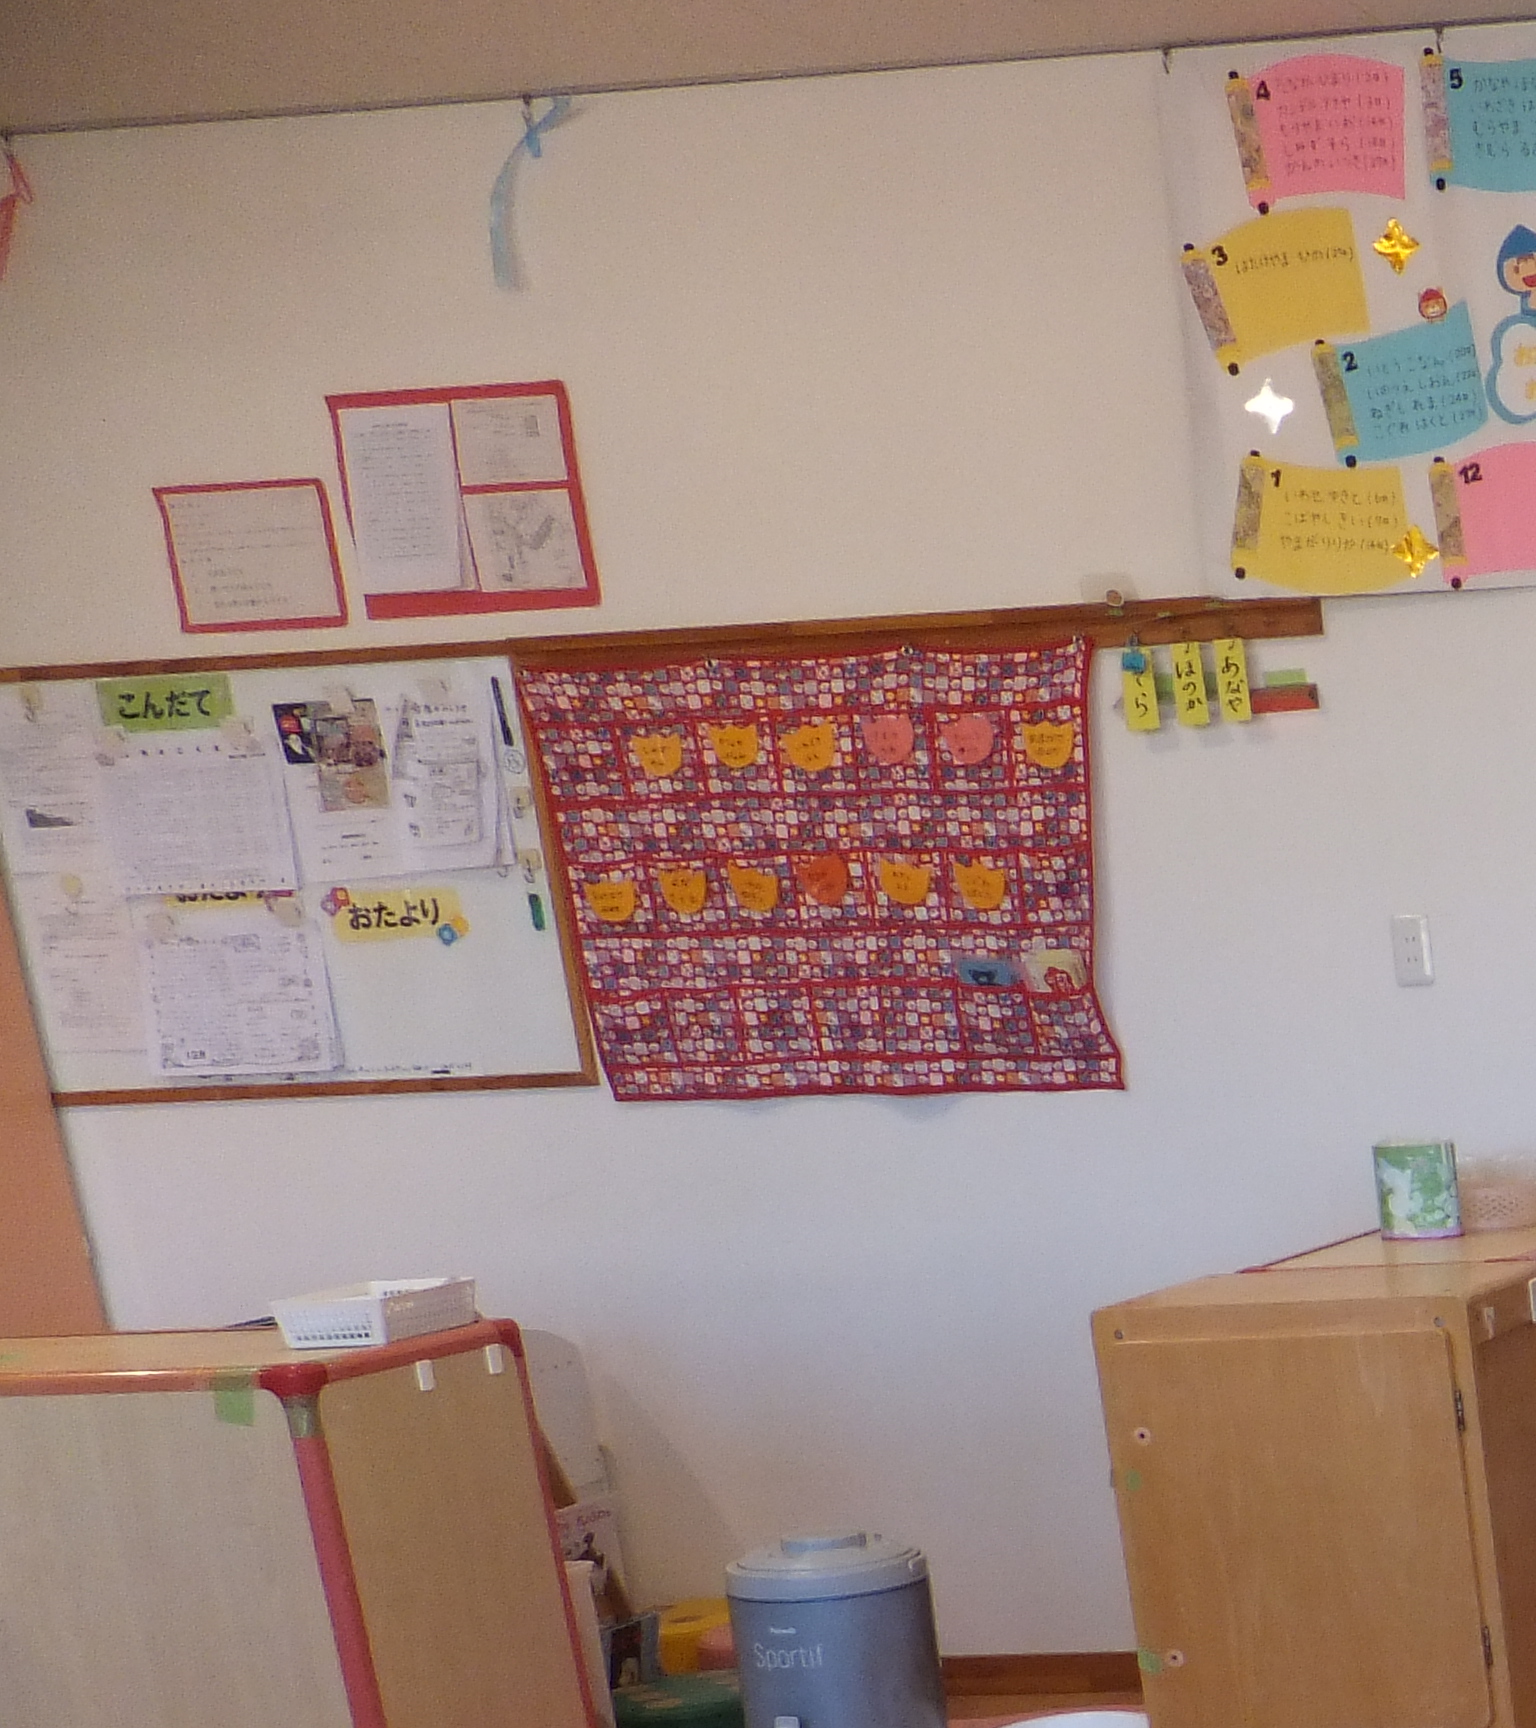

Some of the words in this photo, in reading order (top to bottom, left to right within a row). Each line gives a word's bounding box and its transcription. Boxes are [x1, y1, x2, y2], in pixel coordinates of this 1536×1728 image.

[1450, 68, 1464, 89] 5
[1256, 80, 1271, 101] 4
[1212, 245, 1228, 266] 3
[1342, 351, 1358, 372] 2
[1270, 469, 1282, 488] 1
[1459, 463, 1483, 484] 12
[118, 689, 211, 719] こんだて
[348, 898, 440, 932] おたより
